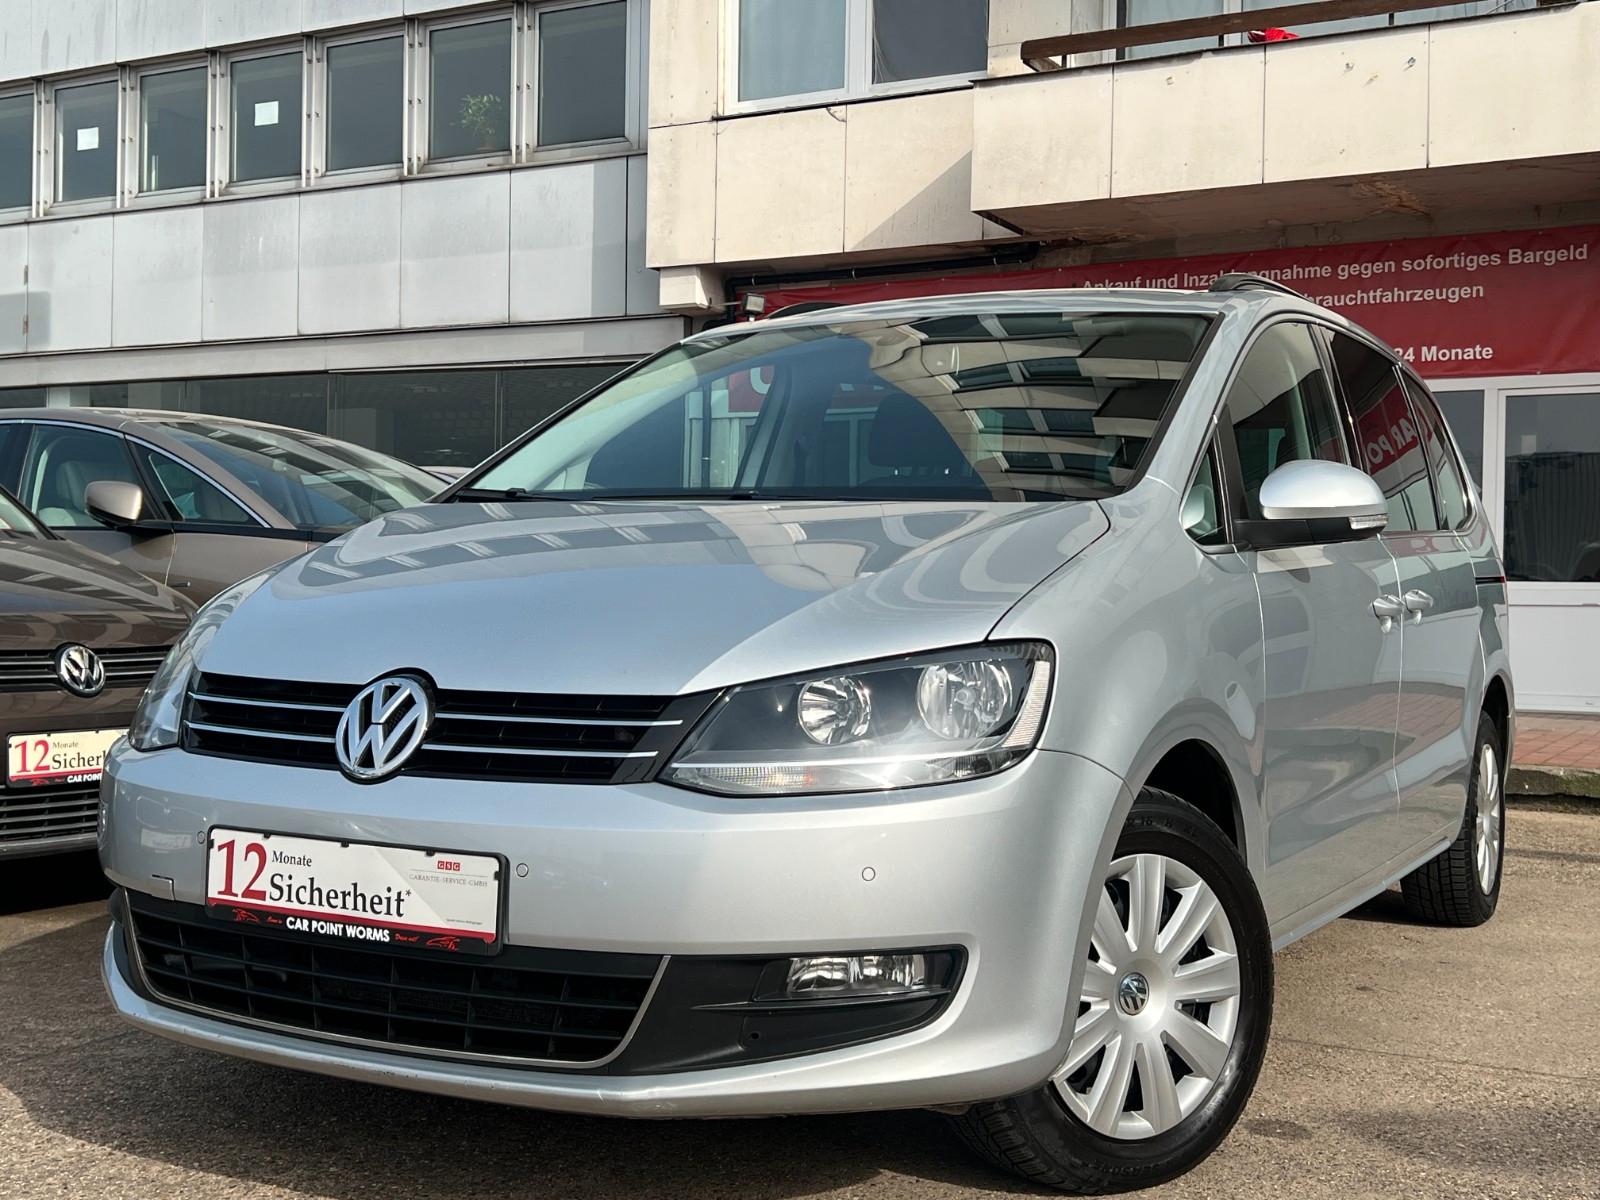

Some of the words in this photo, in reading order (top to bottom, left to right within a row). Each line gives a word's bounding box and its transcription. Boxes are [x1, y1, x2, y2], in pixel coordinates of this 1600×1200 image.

[1146, 273, 1178, 289] und
[1183, 264, 1332, 288] Inzagnahme
[1337, 260, 1396, 280] gegen
[1401, 252, 1501, 272] sofortiges
[1508, 244, 1588, 266] Bargeld
[1421, 344, 1493, 362] Monate
[15, 740, 51, 773] 12
[67, 775, 82, 783] CAR
[217, 839, 267, 902] 12
[271, 850, 312, 867] Monate
[437, 860, 461, 871] GSG
[286, 917, 310, 932] CAR
[311, 920, 344, 936] POINT
[345, 924, 390, 942] WORMS
